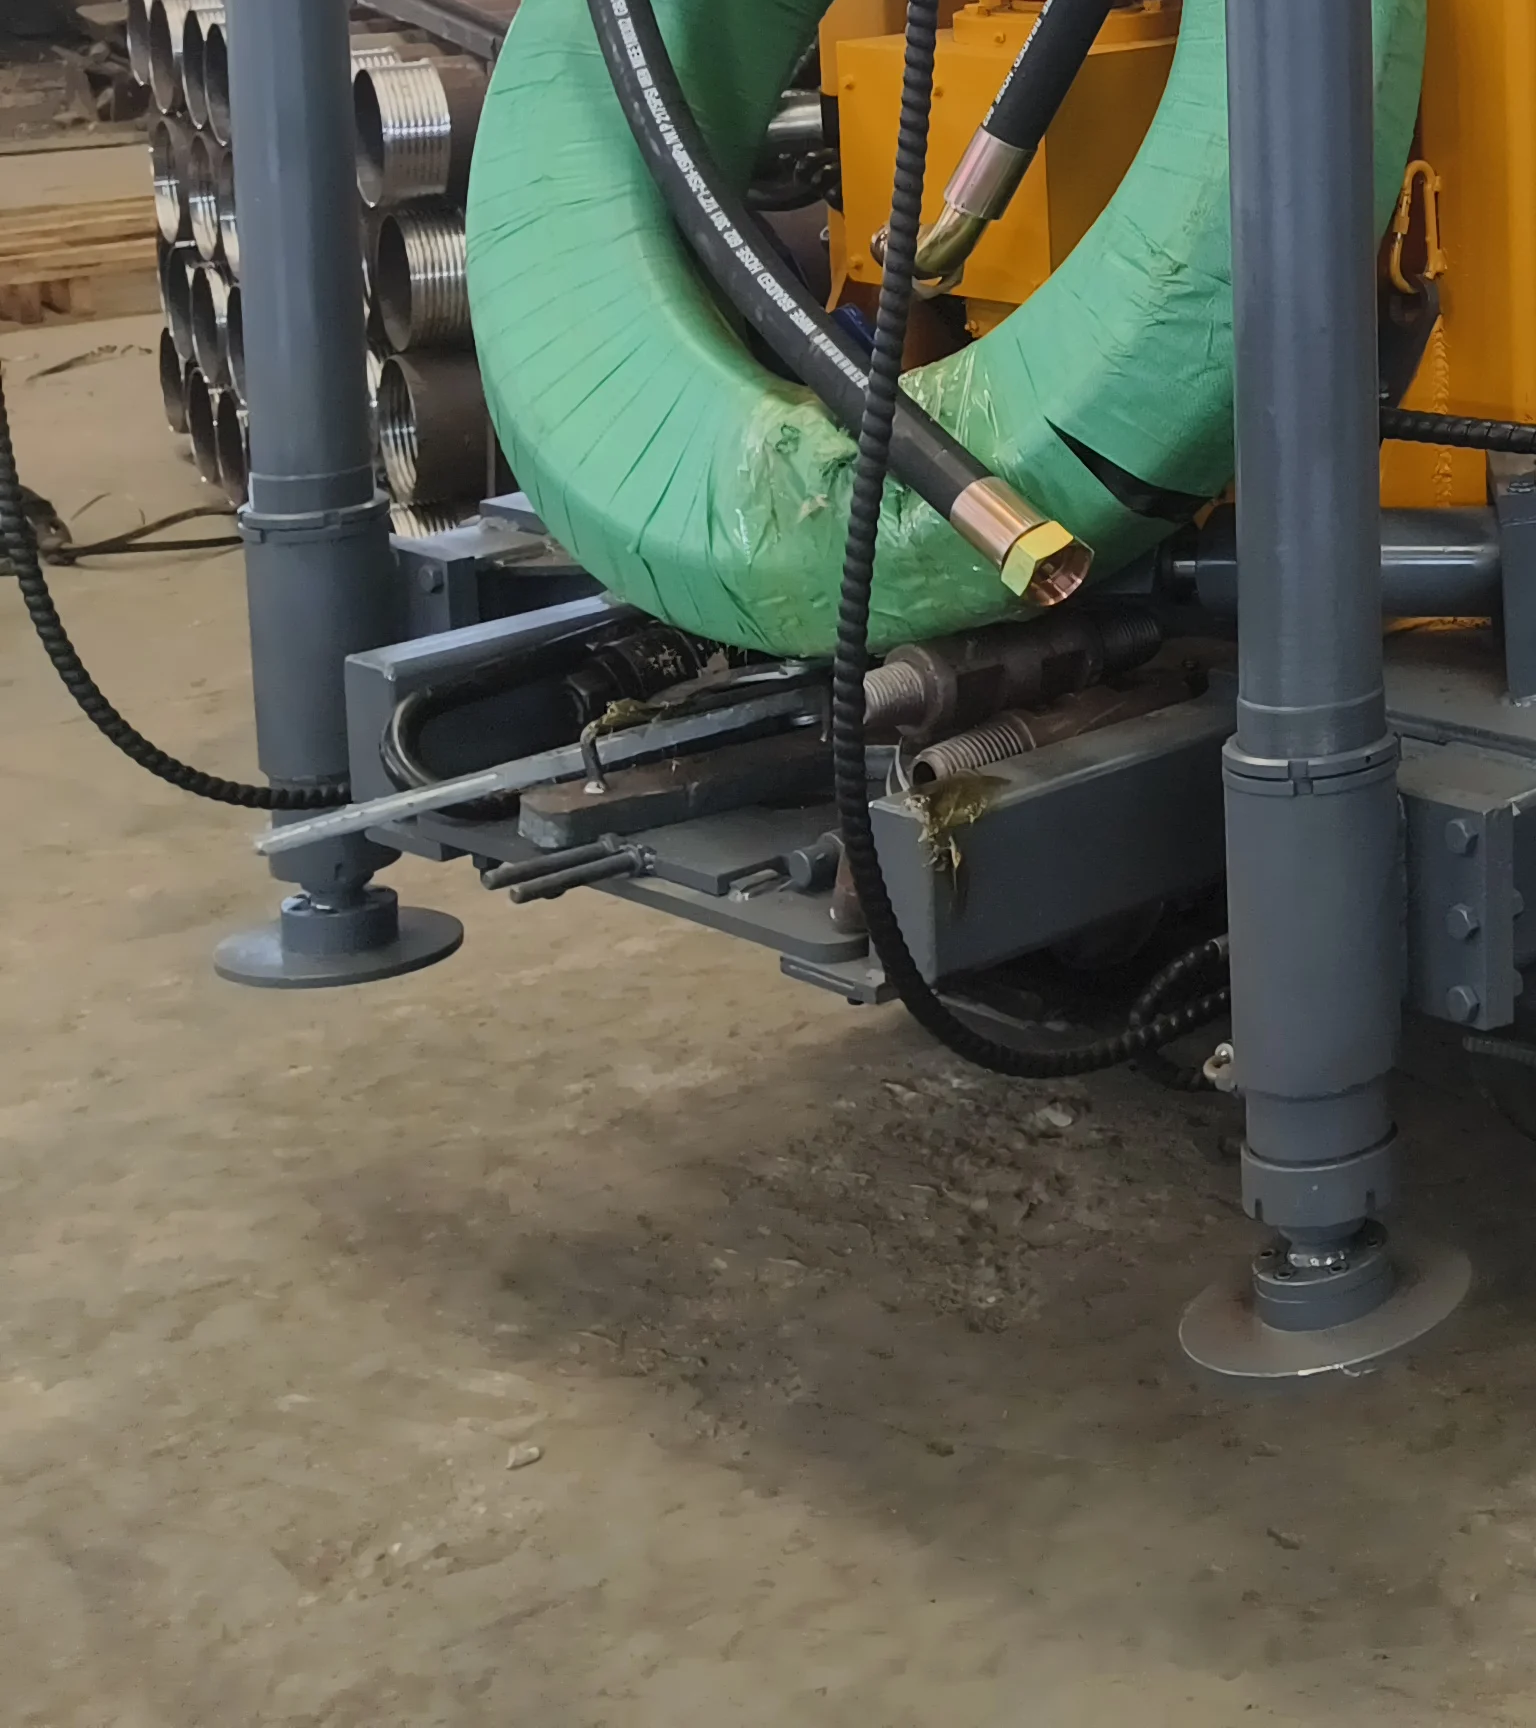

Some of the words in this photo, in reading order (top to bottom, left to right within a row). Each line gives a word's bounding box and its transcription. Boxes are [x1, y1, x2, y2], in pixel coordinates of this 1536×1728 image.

[1013, 17, 1042, 68] BRAIDED
[735, 245, 765, 275] HOSE
[757, 272, 797, 313] BRAIDED
[789, 308, 818, 336] WIRE
